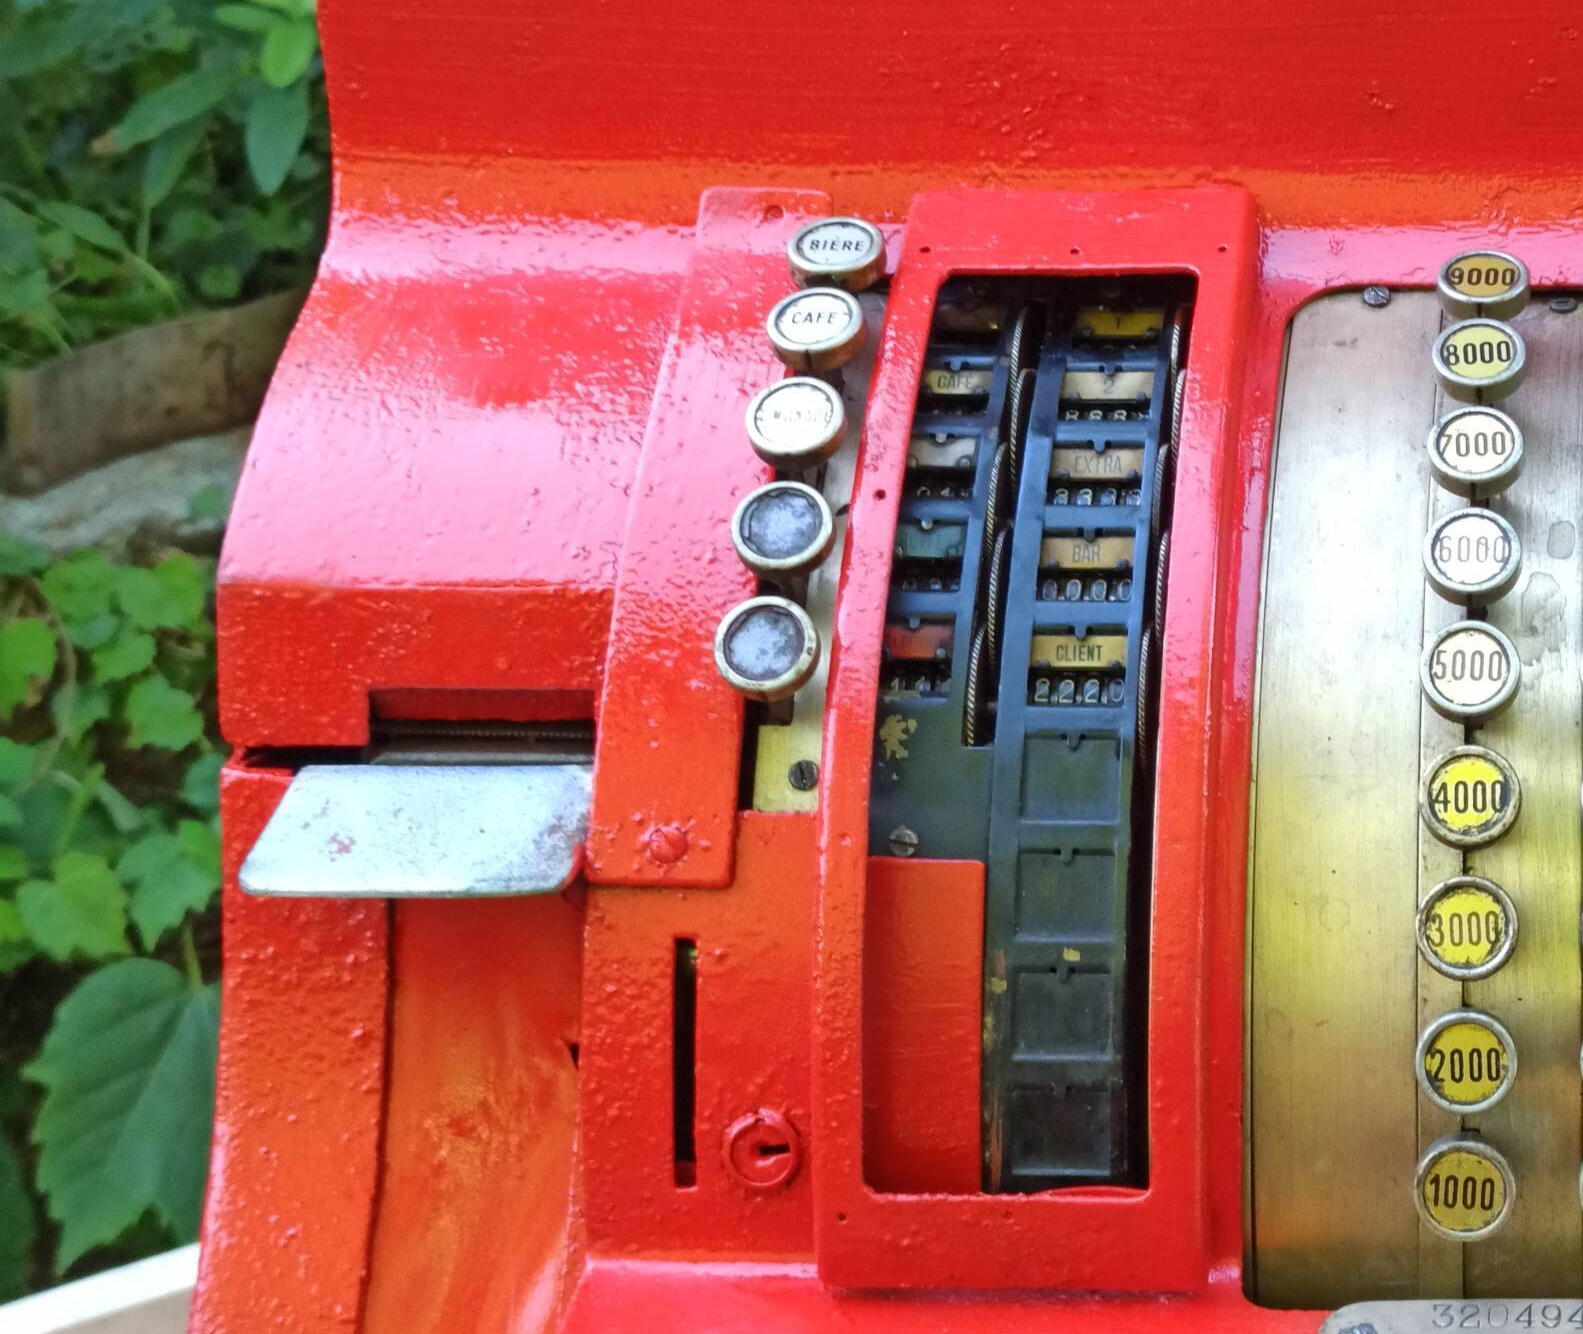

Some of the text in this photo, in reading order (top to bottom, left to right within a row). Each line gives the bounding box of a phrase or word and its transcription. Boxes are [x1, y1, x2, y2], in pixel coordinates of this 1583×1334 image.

[1450, 266, 1516, 287] 9000
[1445, 340, 1512, 366] 8000
[1440, 431, 1507, 458] 7000
[1074, 454, 1123, 475] EXTRA
[1072, 544, 1101, 564] BAR
[1438, 535, 1506, 565] 6000
[1055, 644, 1104, 662] CLIENT
[1433, 649, 1504, 682] 5000
[1432, 779, 1502, 814] 4000
[1430, 910, 1499, 947] 3000
[1430, 1046, 1500, 1084] 2000
[1428, 1173, 1496, 1212] 1000
